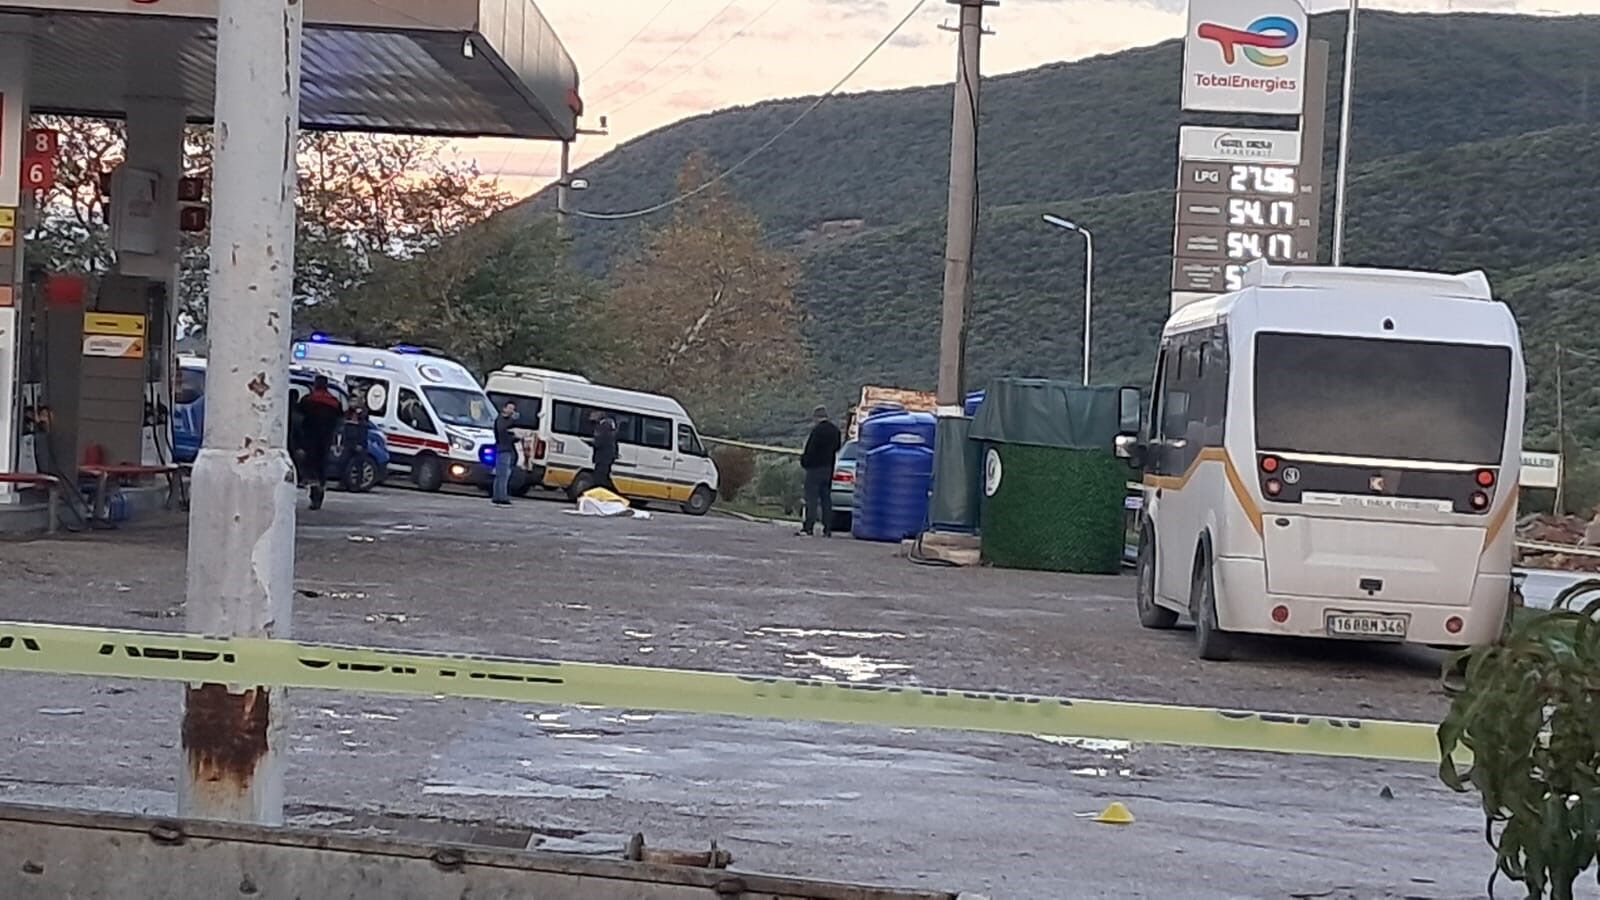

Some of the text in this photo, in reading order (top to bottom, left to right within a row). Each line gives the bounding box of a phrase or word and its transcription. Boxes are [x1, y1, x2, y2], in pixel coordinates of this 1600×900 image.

[1195, 74, 1296, 91] TotalEnergies
[35, 133, 48, 151] 8
[30, 164, 43, 182] 6
[1194, 170, 1219, 183] LPG
[1230, 200, 1293, 225] 54.17
[1228, 233, 1292, 258] 54.17
